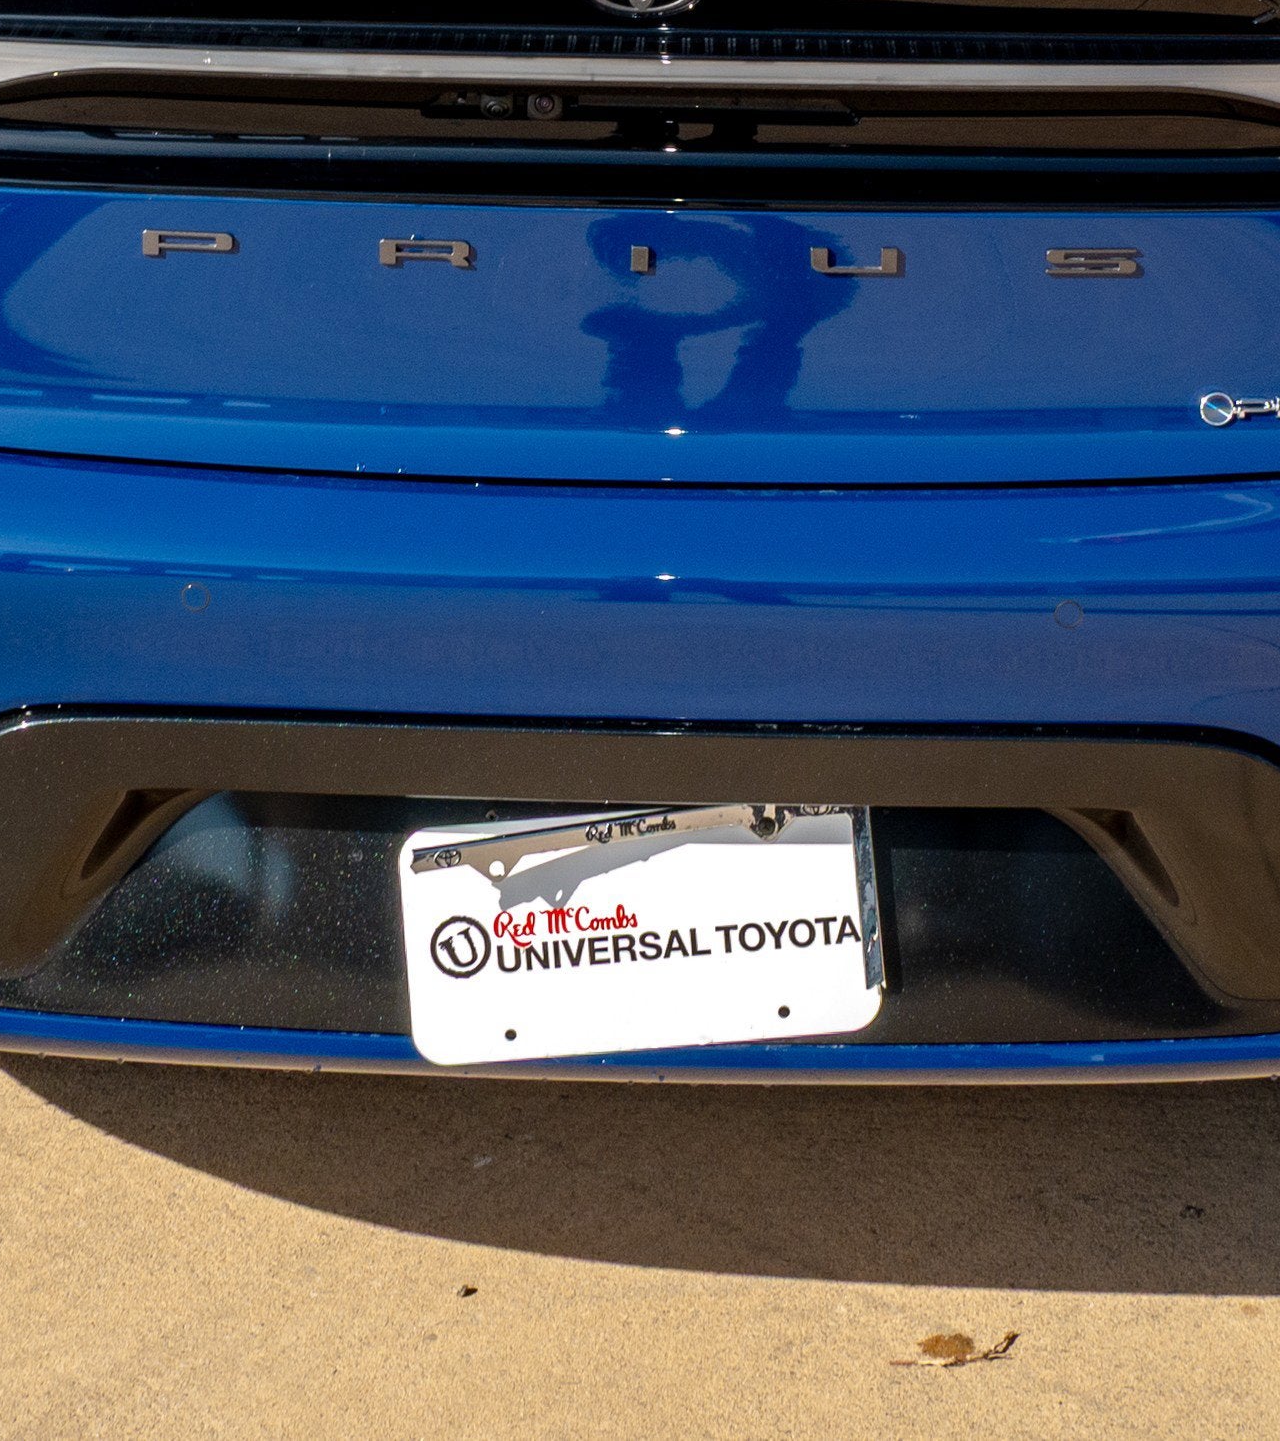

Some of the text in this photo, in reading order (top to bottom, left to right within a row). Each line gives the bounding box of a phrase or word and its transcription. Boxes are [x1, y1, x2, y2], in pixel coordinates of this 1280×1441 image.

[142, 228, 1138, 276] PRIUS
[585, 814, 676, 844] Red McCombs
[493, 904, 638, 947] Red McCombs
[496, 927, 712, 973] UNIVERSAL
[714, 914, 862, 954] TOYOTA
